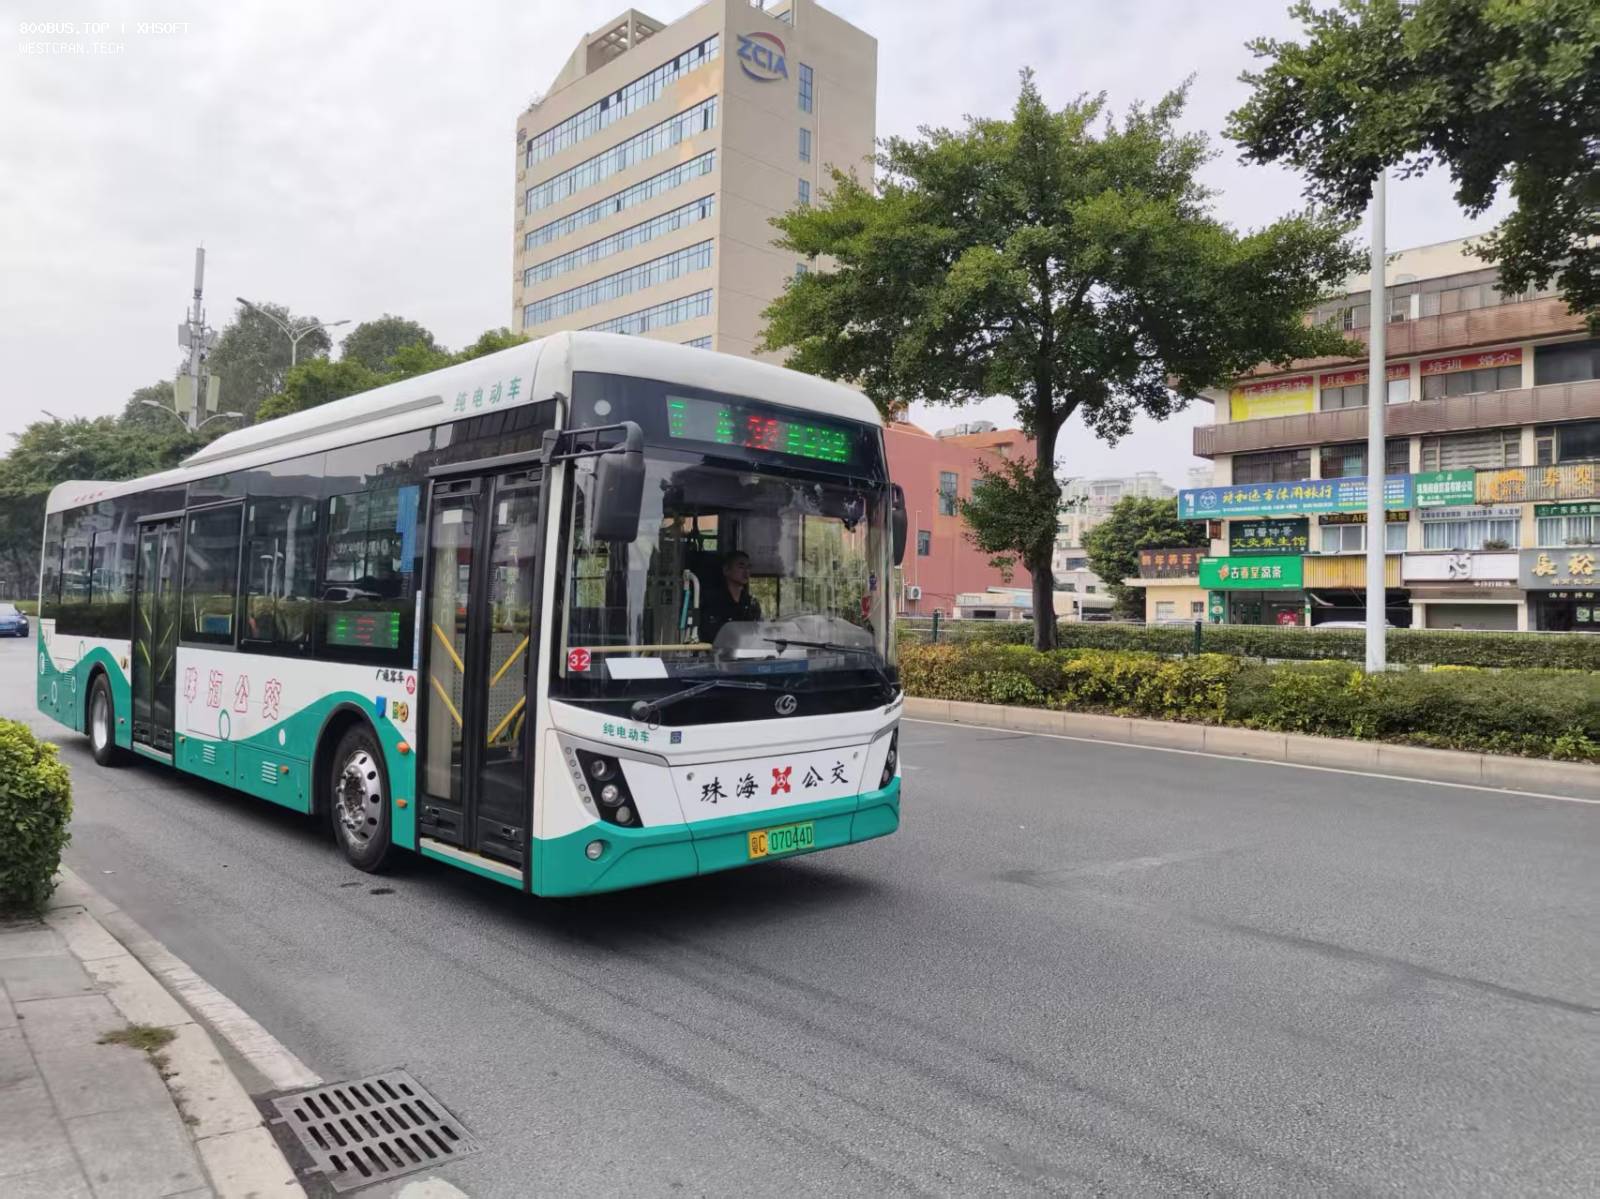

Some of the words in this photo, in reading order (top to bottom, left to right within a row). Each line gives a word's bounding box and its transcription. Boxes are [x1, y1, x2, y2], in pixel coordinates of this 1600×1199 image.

[454, 376, 522, 413] 纯电动车
[1231, 536, 1307, 548] 艾灸养生馆
[568, 654, 591, 667] 32
[602, 722, 650, 743] 纯电动车
[700, 772, 759, 804] 珠海
[802, 760, 849, 789] 公交
